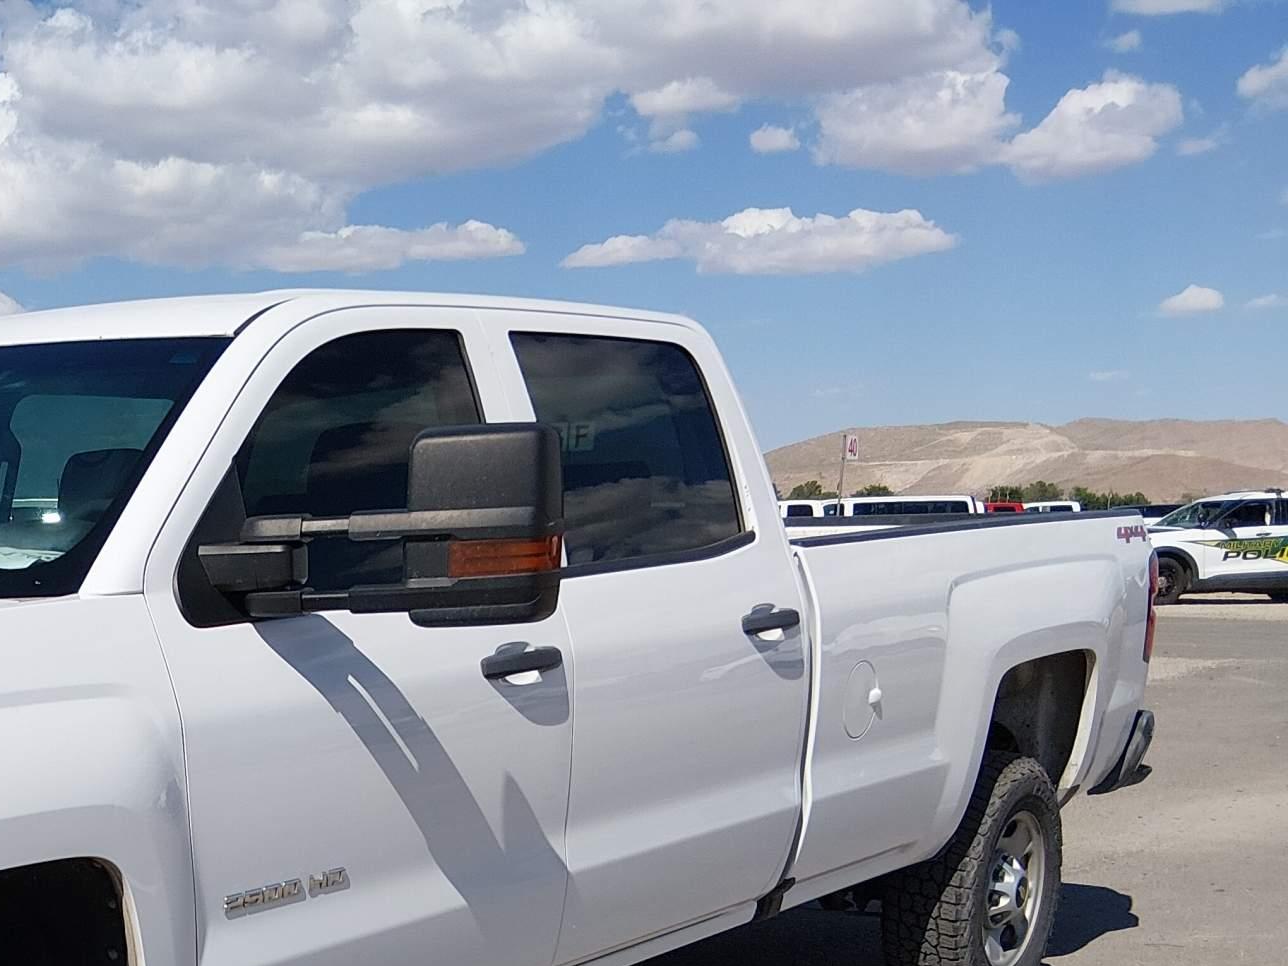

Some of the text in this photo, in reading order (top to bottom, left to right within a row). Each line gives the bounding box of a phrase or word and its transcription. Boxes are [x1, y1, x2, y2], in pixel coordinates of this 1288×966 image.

[848, 437, 858, 456] 40
[1220, 539, 1281, 550] MILITARY
[1222, 547, 1288, 561] POLI
[309, 867, 350, 895] HD
